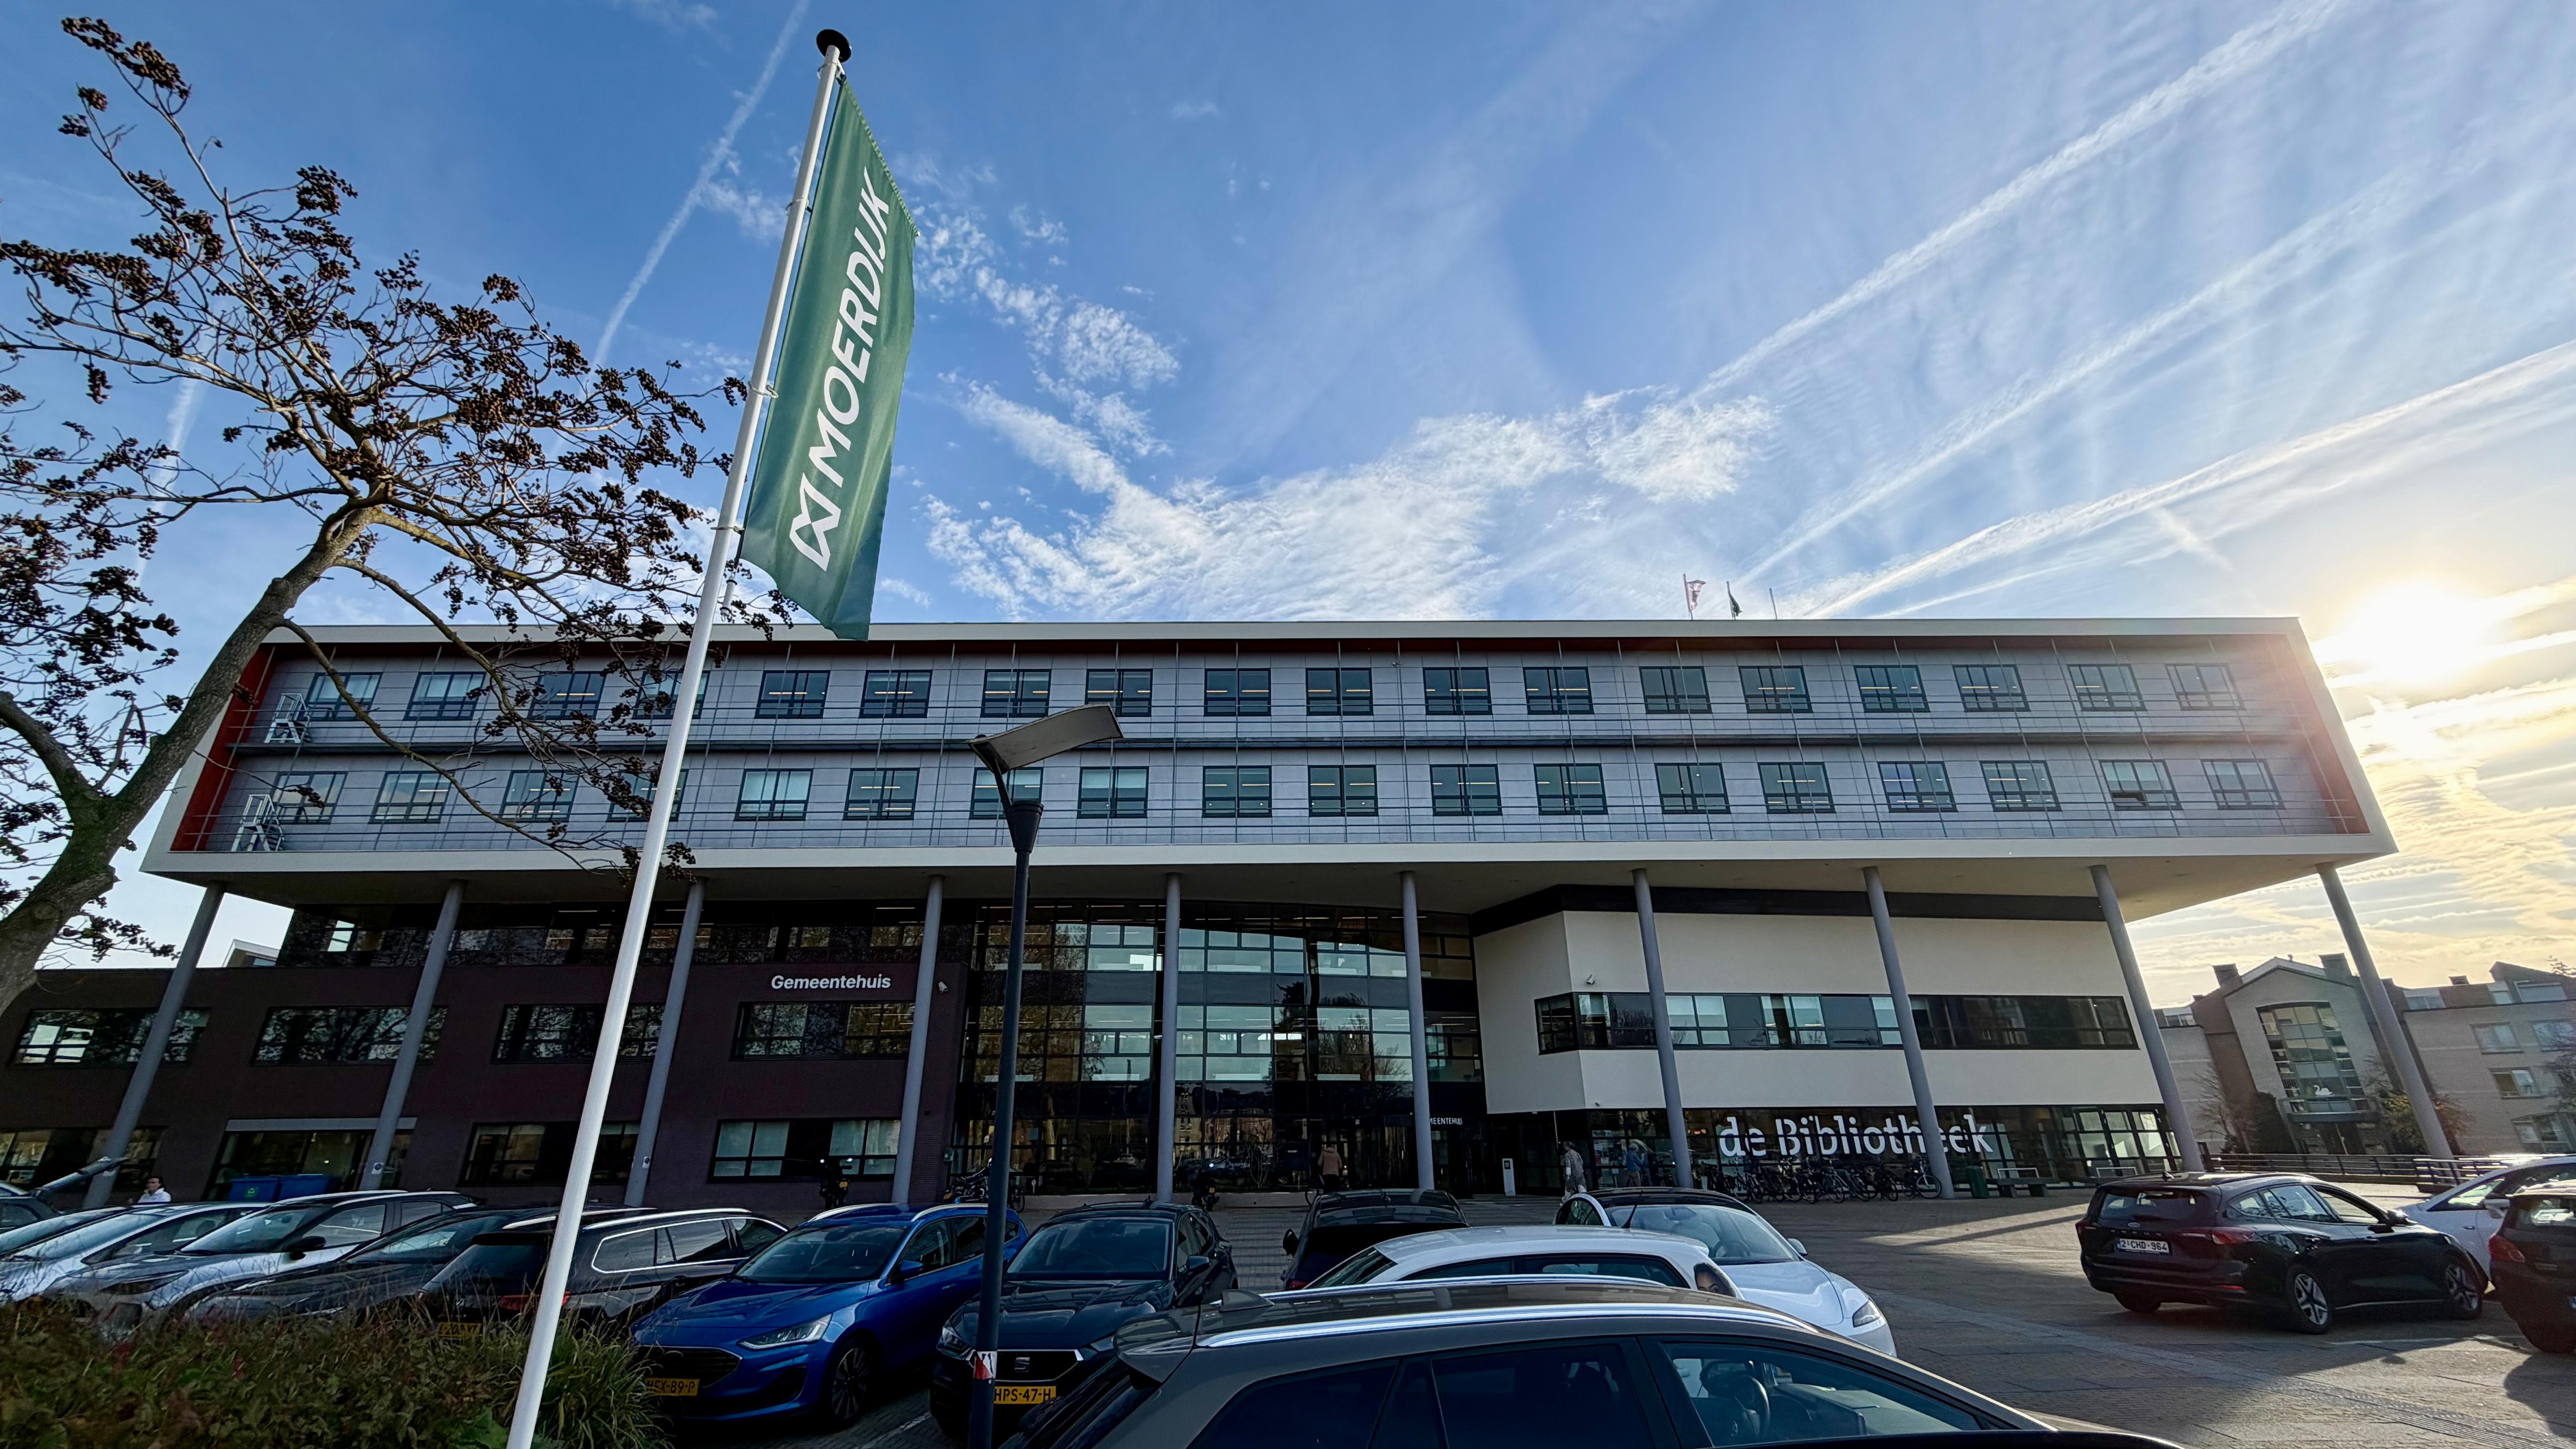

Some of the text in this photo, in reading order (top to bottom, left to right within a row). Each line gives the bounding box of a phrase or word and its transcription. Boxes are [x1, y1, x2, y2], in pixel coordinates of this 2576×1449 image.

[809, 166, 889, 487] MOERDIJK
[771, 974, 891, 989] Gemeentehuis
[1719, 1116, 1766, 1157] de
[994, 1388, 1052, 1402] HPS-47-H
